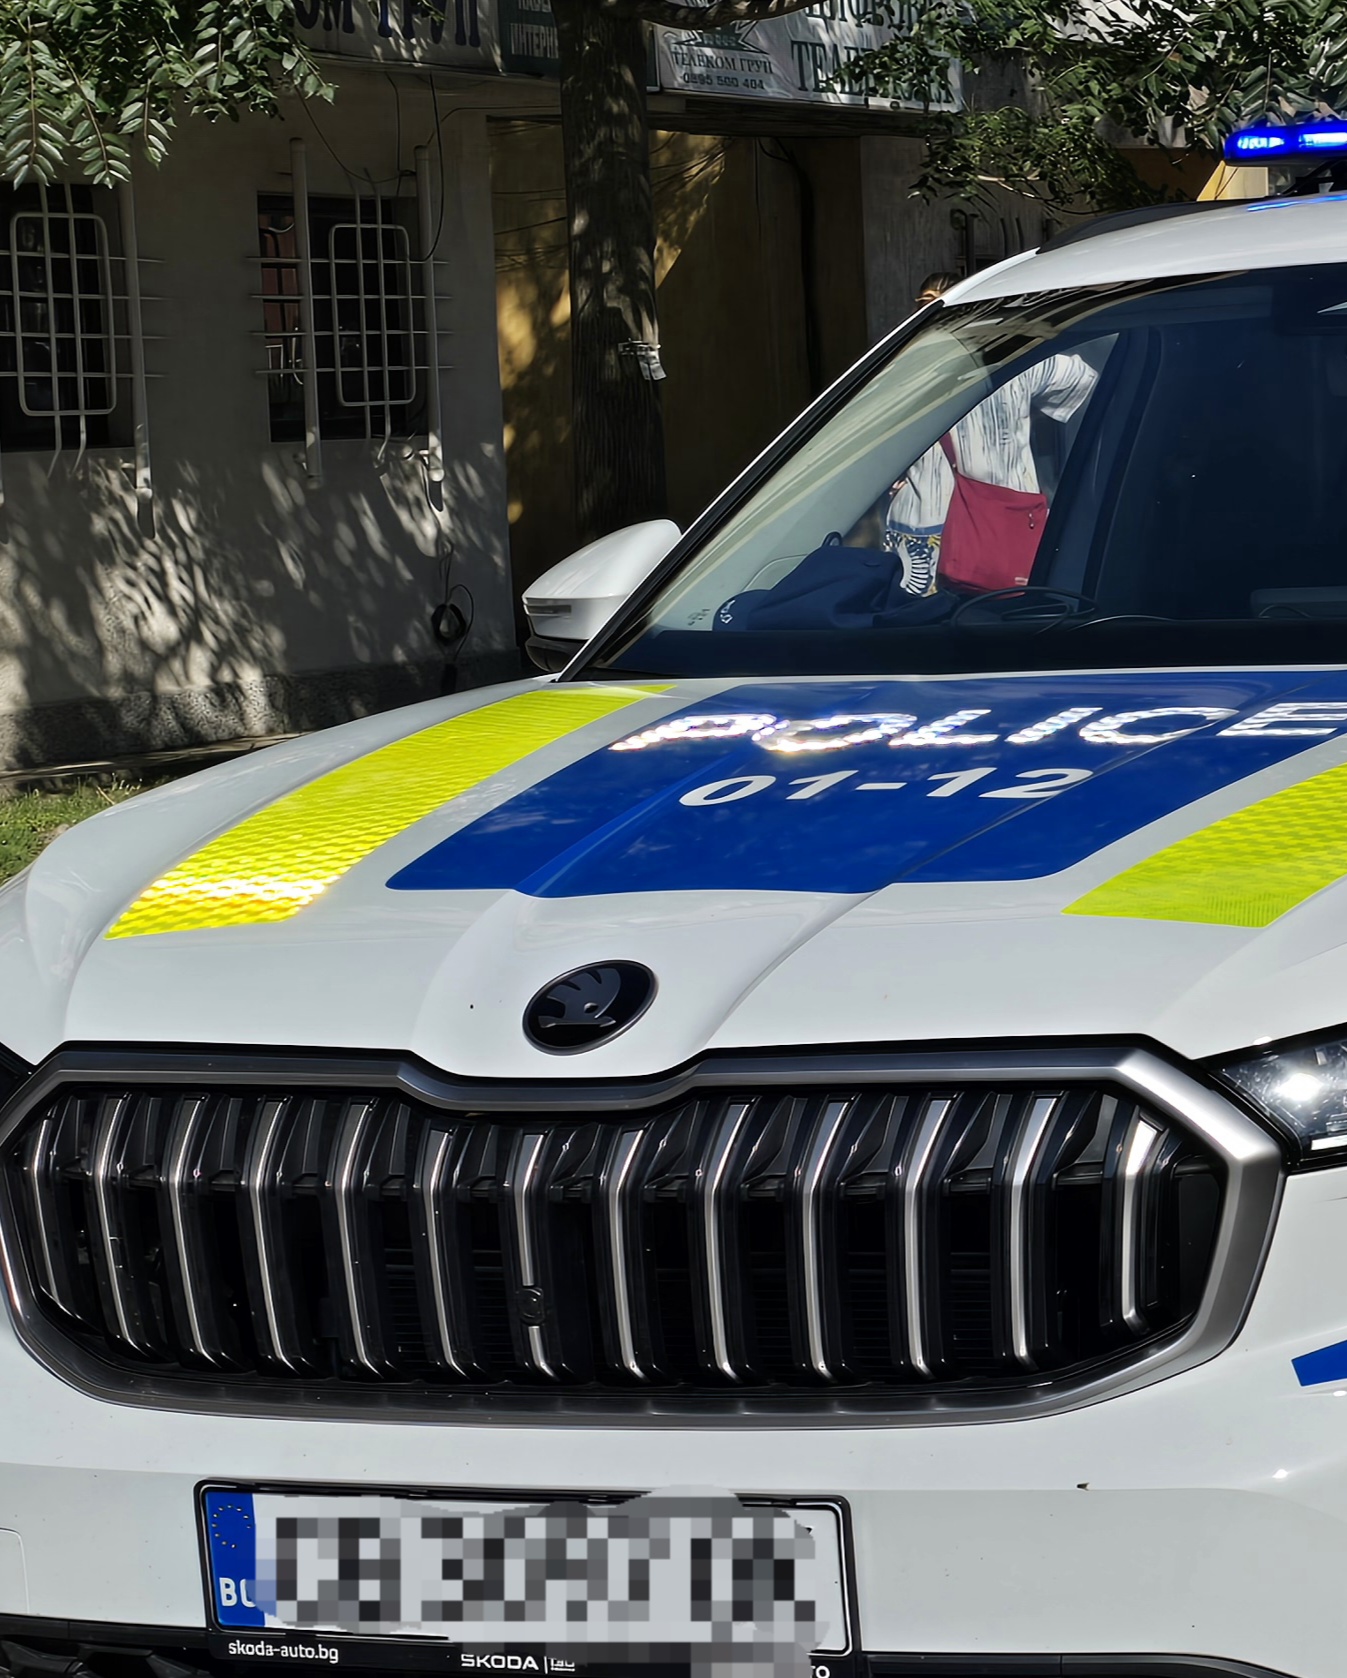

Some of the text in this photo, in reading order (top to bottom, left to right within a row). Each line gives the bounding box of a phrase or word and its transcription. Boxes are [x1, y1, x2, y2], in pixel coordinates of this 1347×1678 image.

[740, 58, 774, 75] ГРУП
[679, 767, 1094, 807] 01-12
[228, 1639, 339, 1665] skoda-auto.bg
